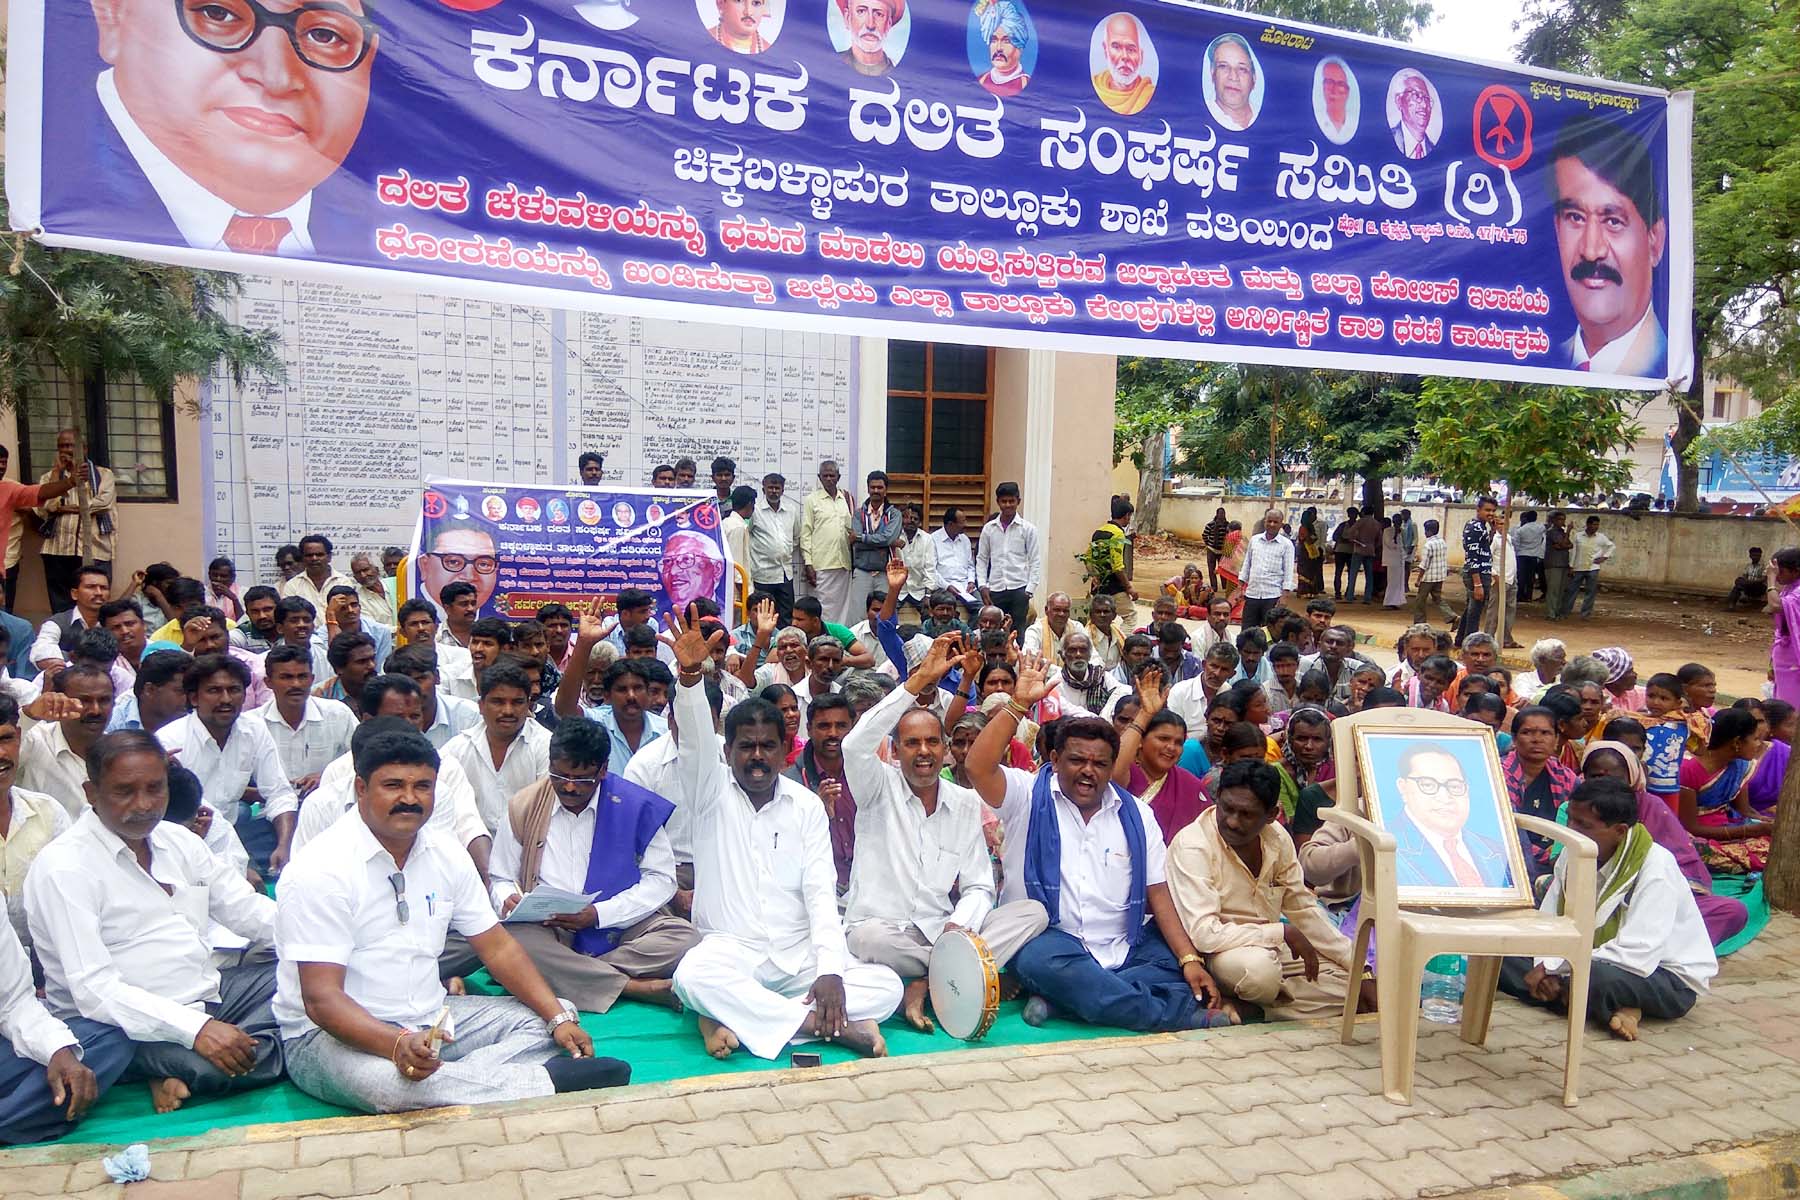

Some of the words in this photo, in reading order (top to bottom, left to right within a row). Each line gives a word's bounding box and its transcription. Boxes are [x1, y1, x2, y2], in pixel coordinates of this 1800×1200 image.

[470, 14, 808, 131] ಕರ್ನಾಟಕ
[849, 76, 1005, 159] ದಲಿತ
[1039, 105, 1249, 198] ಸಂಘರ್ಷ
[1276, 140, 1417, 209] ಸಮಿತಿ
[1444, 161, 1522, 227] (ರಿ)
[377, 168, 470, 214] ದಲಿತ
[486, 182, 706, 257] ಚಳುವಳಿಯನ್ನು
[720, 214, 806, 255] ಧಮನ
[819, 227, 925, 268] ಮಾಡಲು
[938, 240, 1106, 288] ಯತ್ನಿಸುತ್ತಿರುವ
[1117, 261, 1232, 294] ಜಿಲ್ಲಾಡಳಿತ
[1241, 266, 1305, 301] ಮತ್ತು
[1310, 272, 1362, 305] ಜಿಲ್ಲಾ
[1467, 285, 1550, 315] ಇಲಾಖೆಯ
[673, 144, 909, 220] ಚಿಕ್ಕಬಳ್ಳಾಪುರ
[930, 181, 1081, 237] ತಾಲ್ಲೂಕು
[1100, 199, 1169, 237] ಶಾಖೆ
[1186, 205, 1335, 251] ವತಿಯಿಂದ
[1476, 223, 1528, 245] 47/74-75
[376, 223, 613, 290] ಧೋರಣೆಯನ್ನು
[623, 261, 776, 304] ಖಂಡಿಸುತ್ತಾ
[786, 274, 878, 309] ಜಿಲ್ಲೆಯ
[890, 285, 954, 318] ಎಲ್ಲಾ
[961, 290, 1076, 325] ತಾಲ್ಲೂಕು
[1086, 294, 1216, 337] ಕೇಂದ್ರಗಳಲ್ಲಿ
[1338, 314, 1384, 341] ಕಾಲ
[1392, 314, 1443, 345] ಧರಣಿ
[1450, 322, 1550, 360] ಕಾರ್ಯಕ್ರಮ
